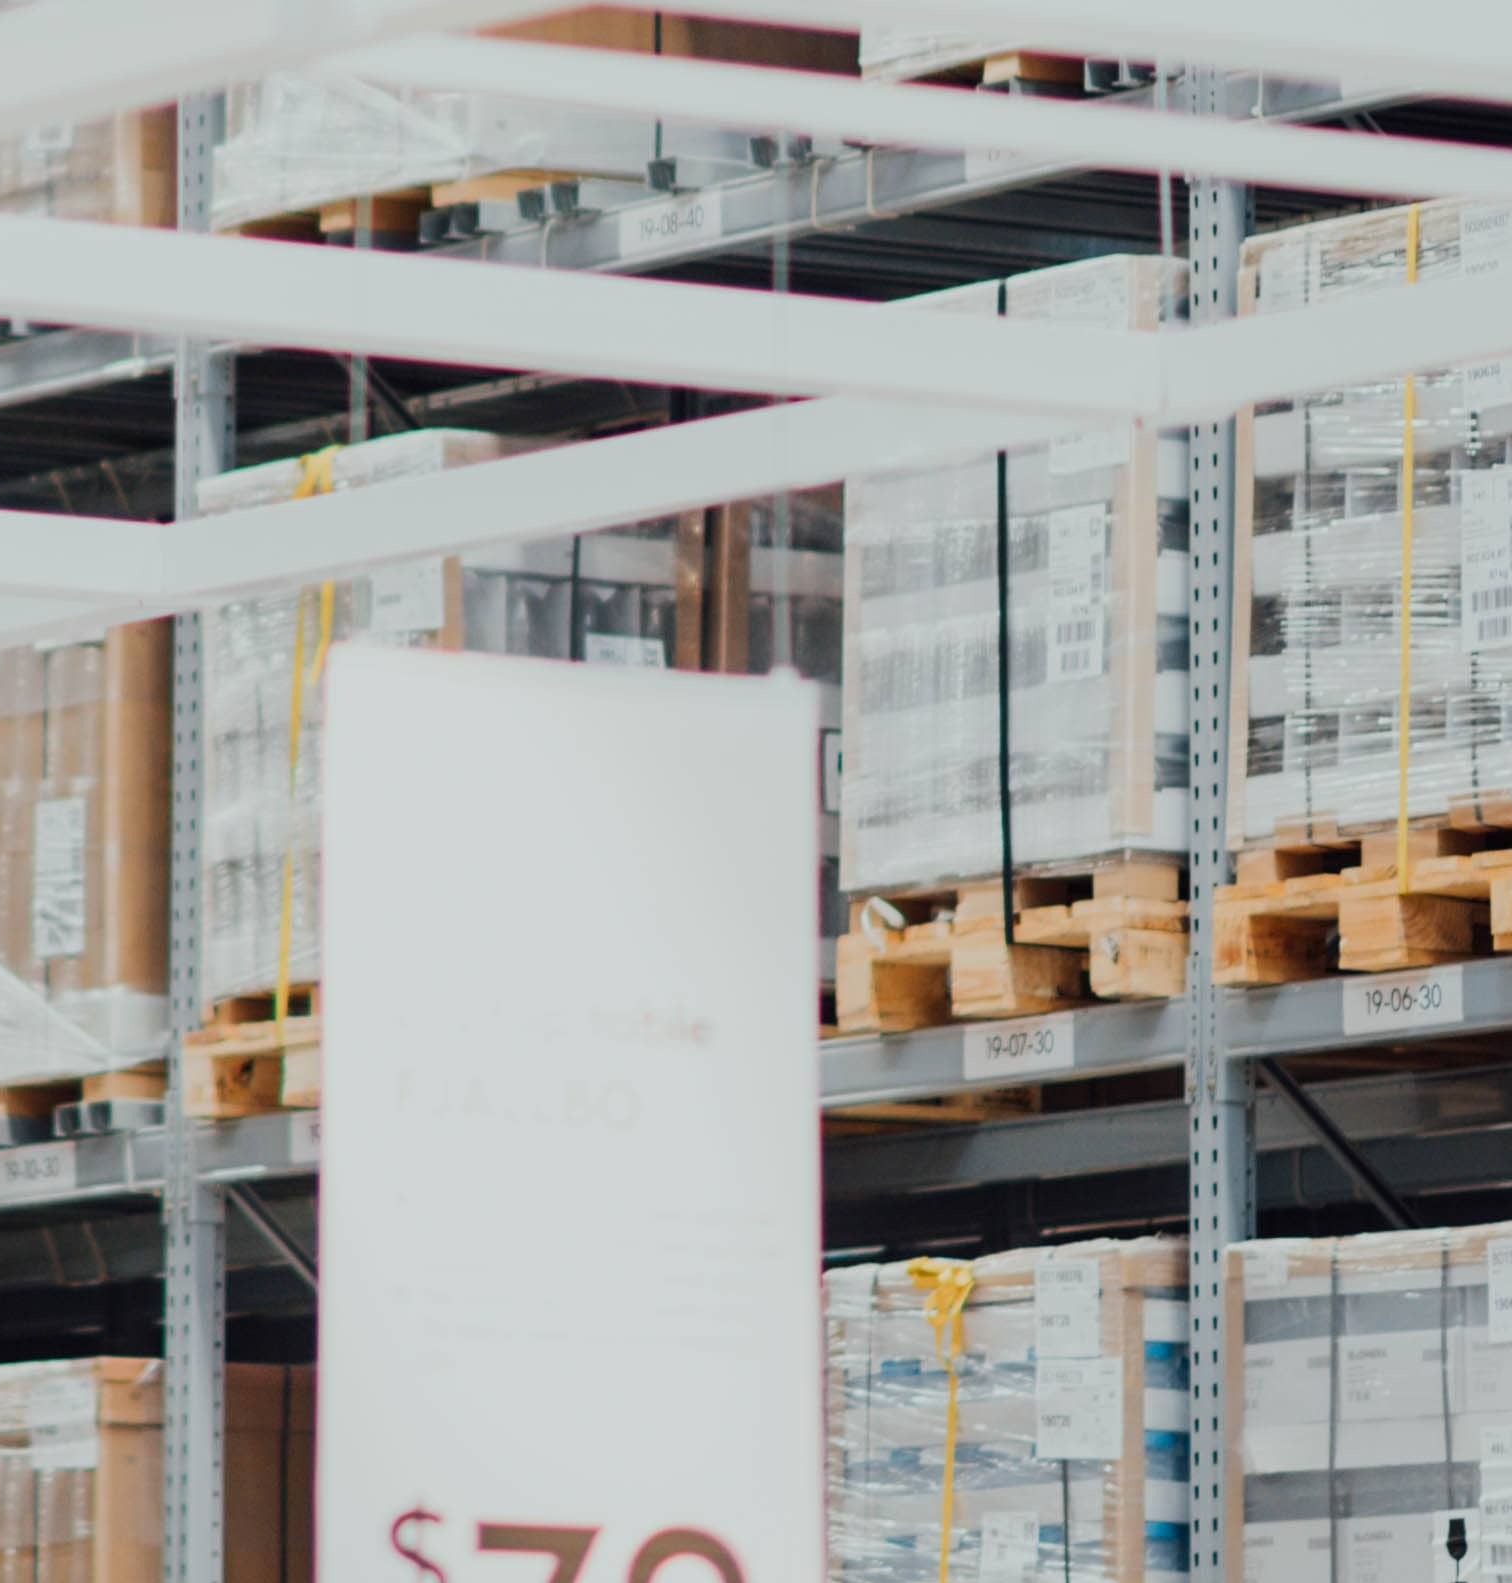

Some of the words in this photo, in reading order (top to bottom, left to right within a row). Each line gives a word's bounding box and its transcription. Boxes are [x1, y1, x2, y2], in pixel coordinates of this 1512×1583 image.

[637, 204, 705, 245] 19-08-40
[1363, 983, 1443, 1017] 19-06-30
[984, 1028, 1056, 1062] 19-07-30
